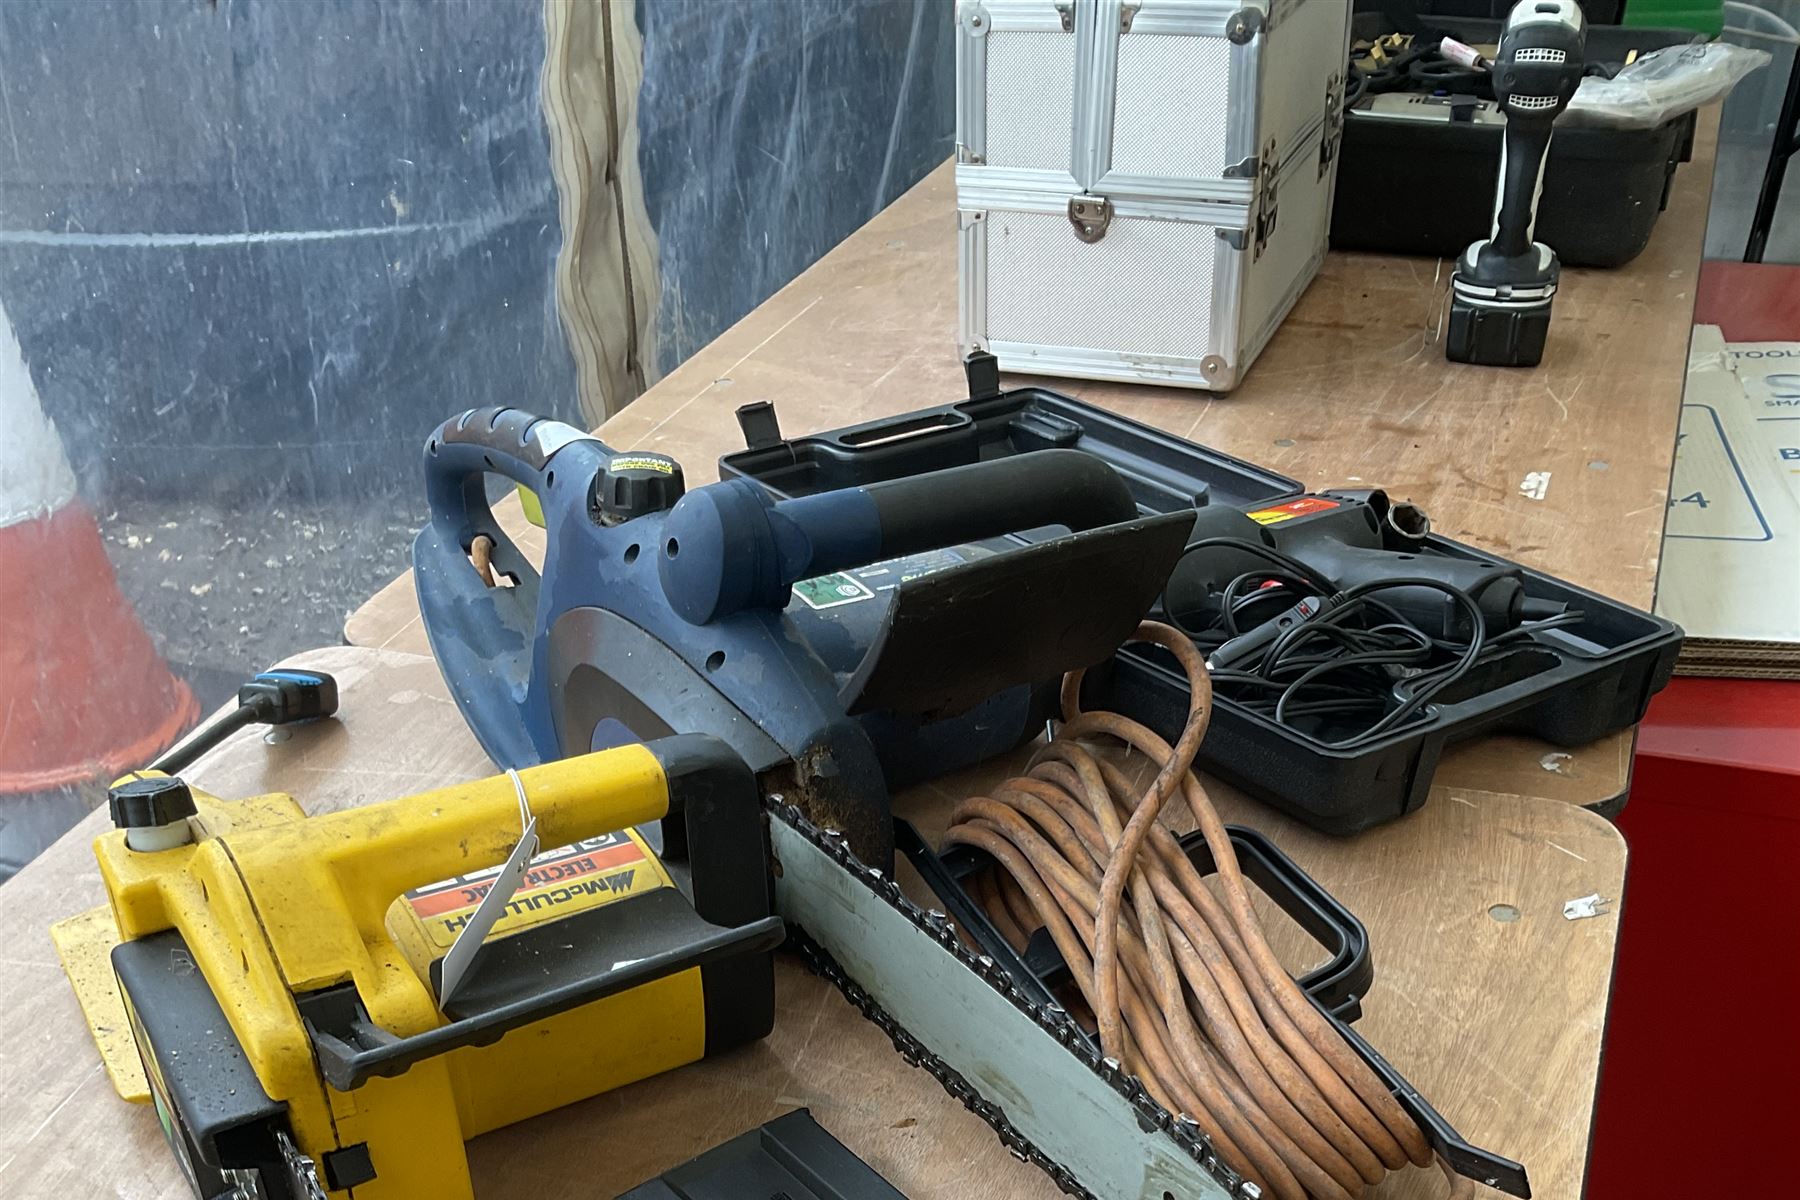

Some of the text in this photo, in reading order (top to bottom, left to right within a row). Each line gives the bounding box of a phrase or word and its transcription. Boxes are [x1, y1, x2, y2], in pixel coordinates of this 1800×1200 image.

[1729, 350, 1800, 359] TOOL
[461, 857, 598, 903] ELECTRAC
[444, 875, 610, 933] McCULLH
